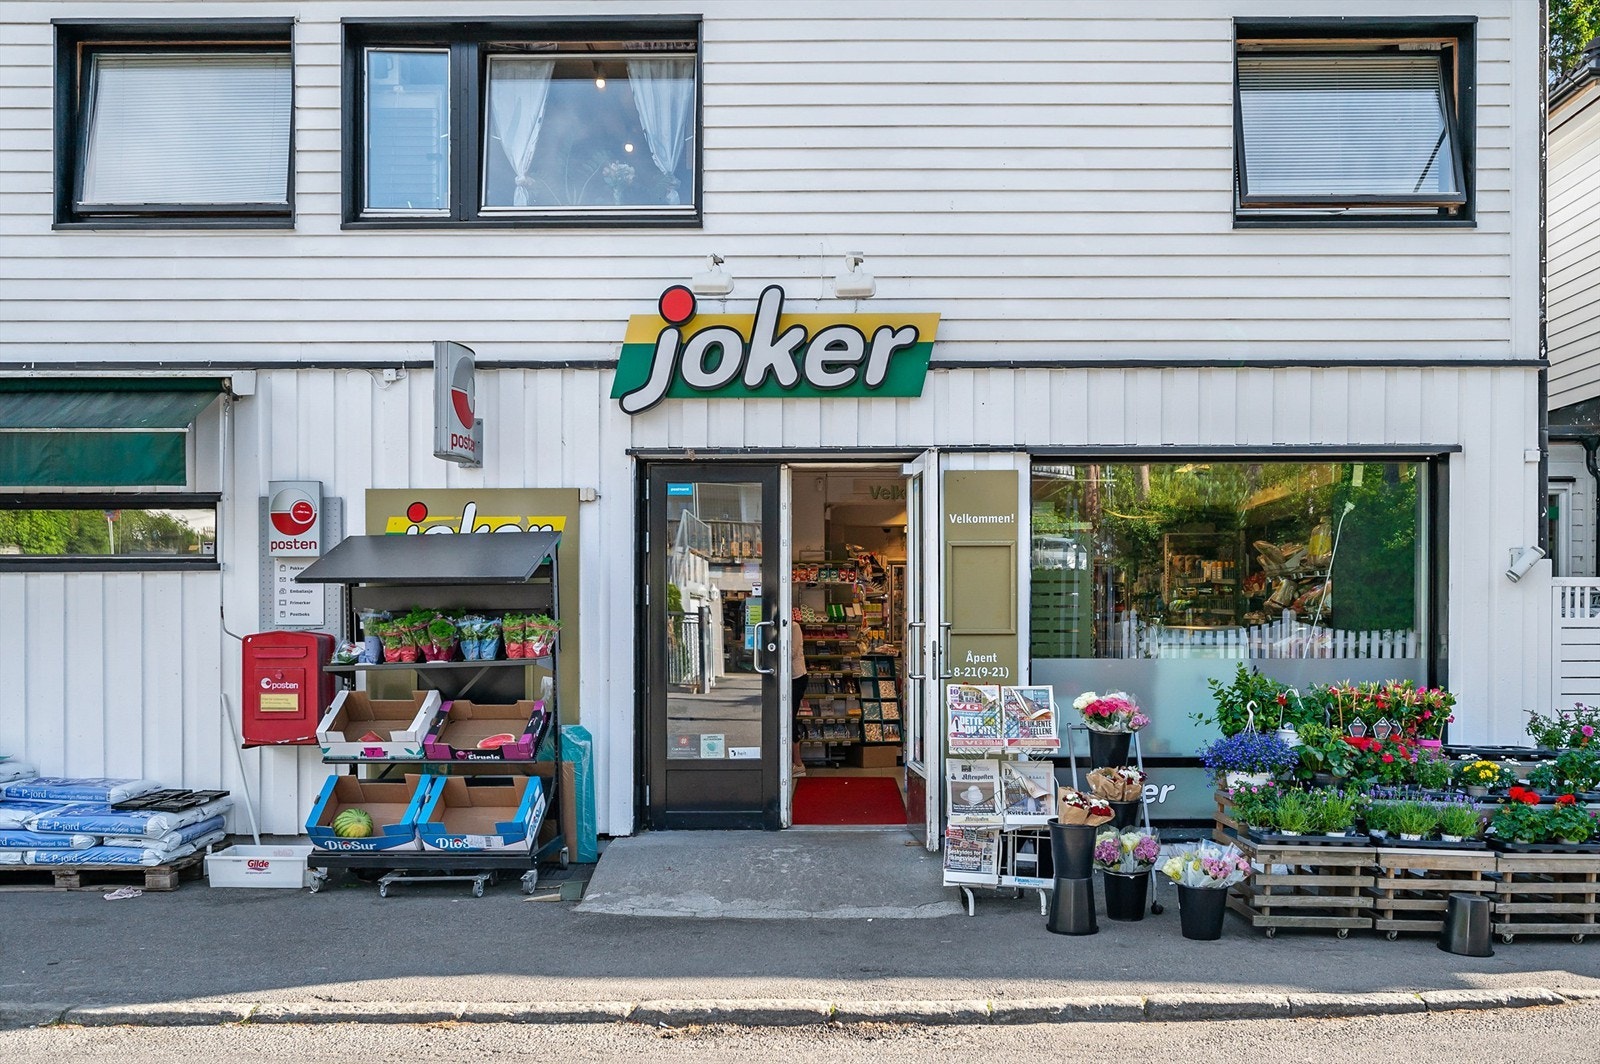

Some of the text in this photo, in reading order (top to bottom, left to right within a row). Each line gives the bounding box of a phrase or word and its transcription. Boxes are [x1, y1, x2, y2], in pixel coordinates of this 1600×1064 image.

[619, 284, 920, 416] joker
[949, 513, 1015, 524] Velkommen!
[270, 538, 318, 552] posten
[966, 651, 998, 664] Åpent
[953, 666, 1009, 679] 8-21(9-21)
[271, 682, 299, 691] posten
[953, 702, 980, 710] VG
[961, 773, 994, 781] Aftenposten
[21, 789, 47, 799] P-jord
[53, 821, 79, 831] P-jord
[324, 840, 377, 850] DioSur
[51, 854, 78, 864] P-jord
[247, 859, 270, 868] Gilde
